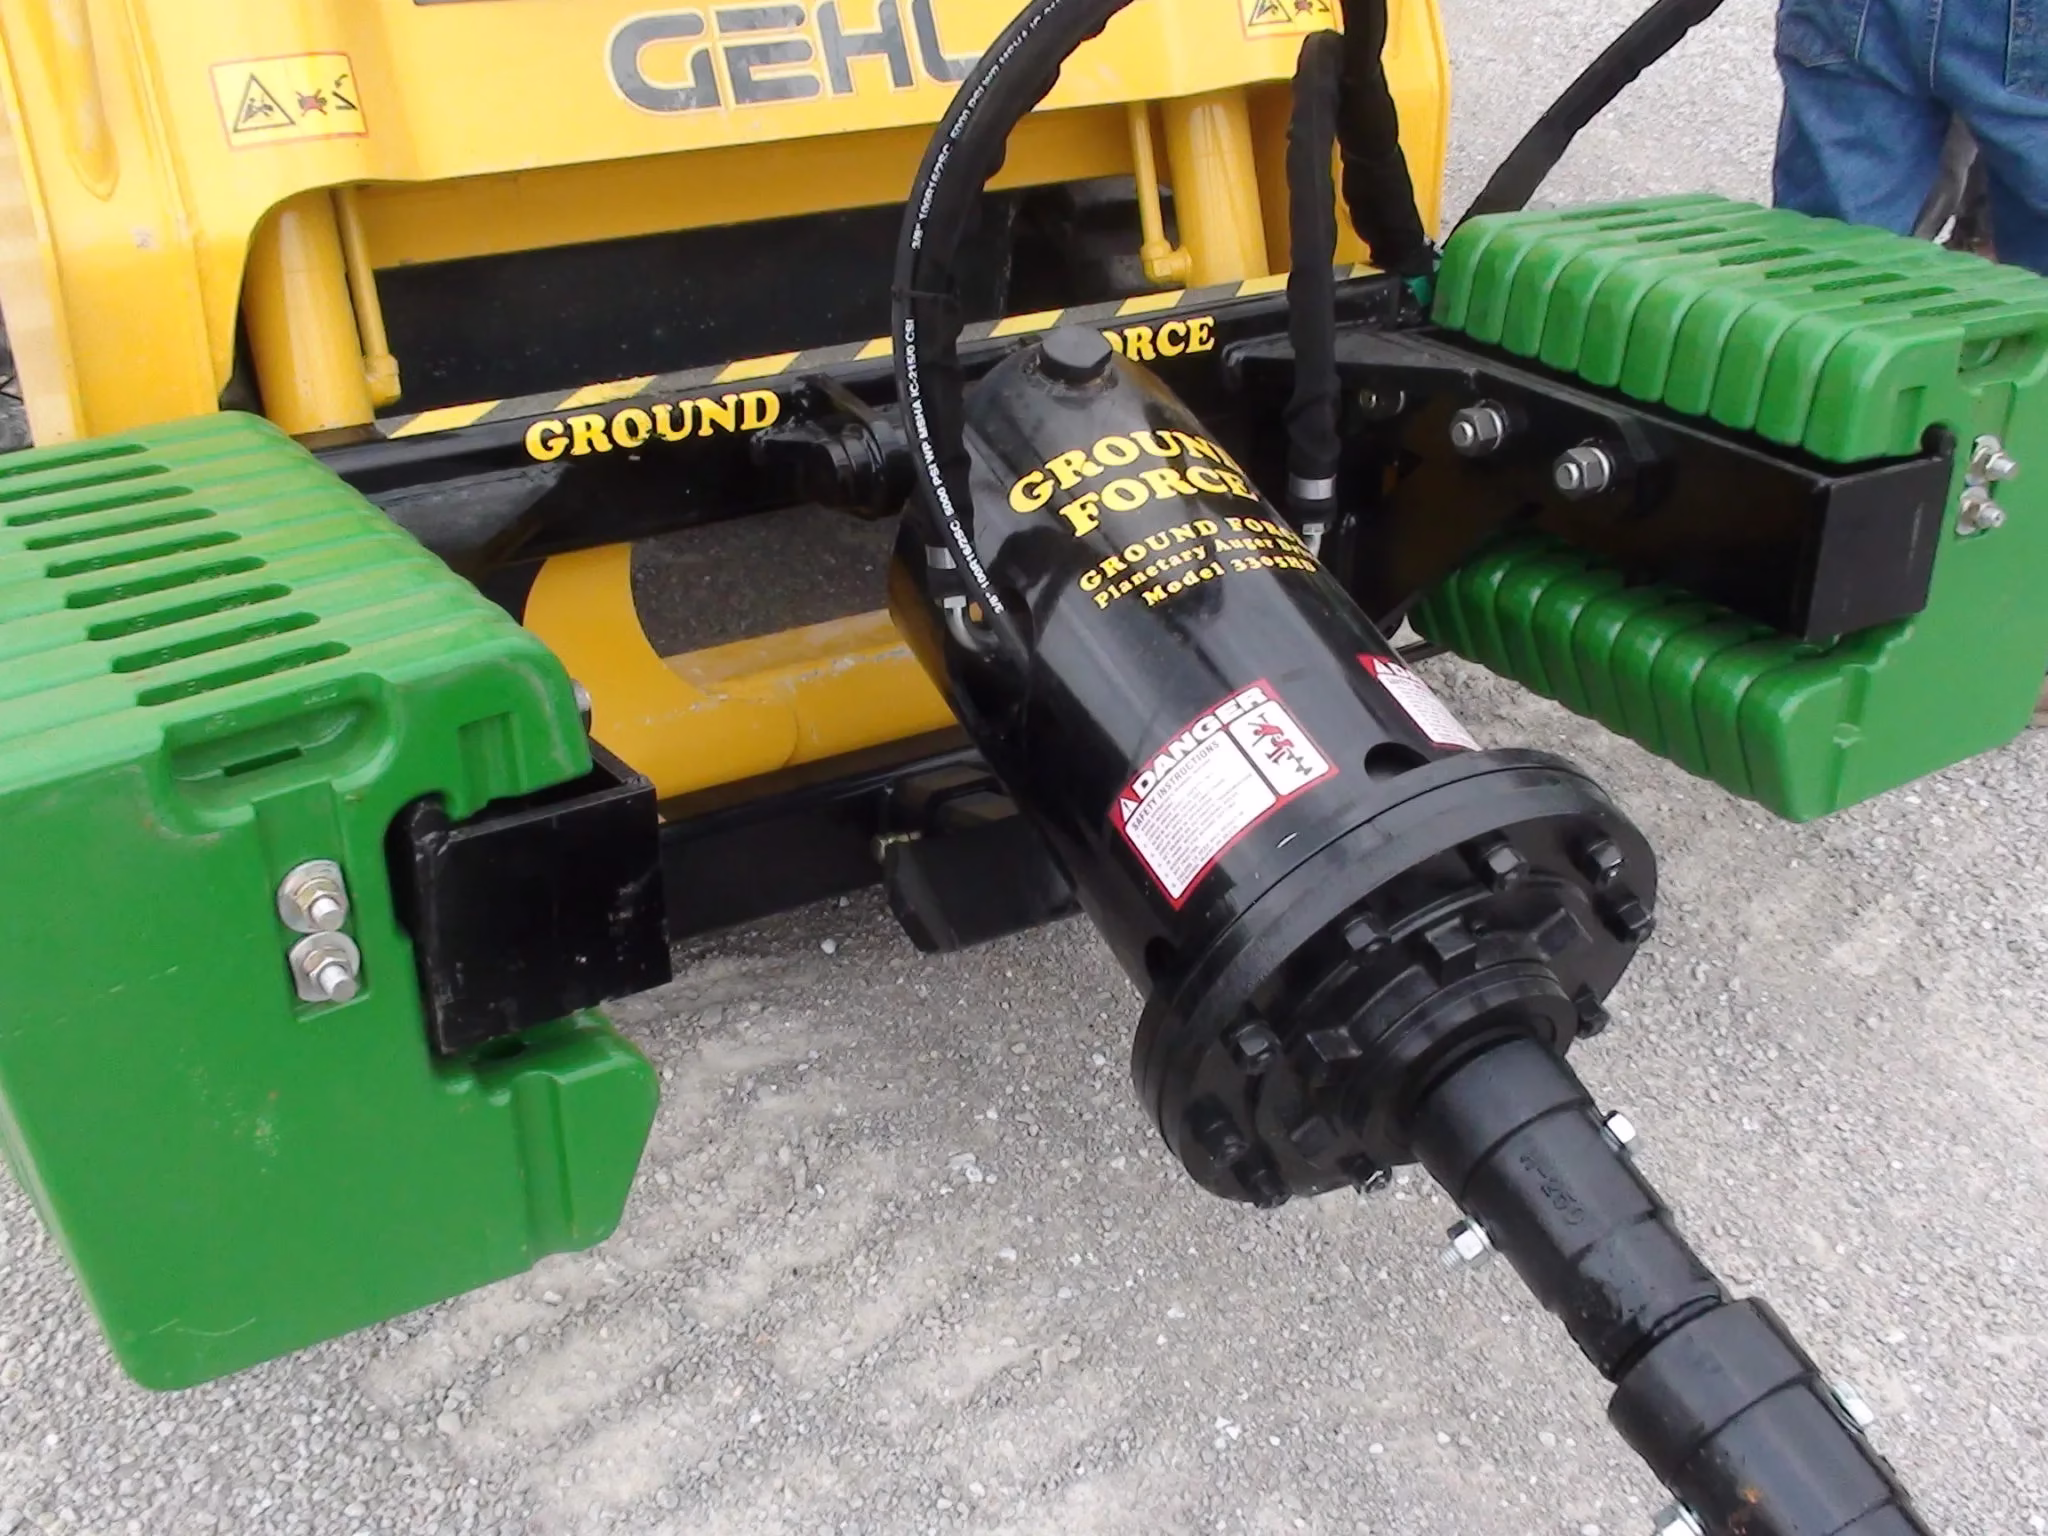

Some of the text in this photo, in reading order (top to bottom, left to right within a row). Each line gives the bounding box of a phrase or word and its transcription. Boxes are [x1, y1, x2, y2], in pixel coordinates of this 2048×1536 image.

[606, 0, 986, 112] GEHL
[905, 319, 915, 341] CSI
[1101, 316, 1216, 362] RCE
[525, 390, 781, 462] GROUND
[911, 398, 930, 442] MSHA
[921, 440, 937, 464] WP
[928, 464, 941, 486] PSI
[936, 486, 955, 517] 5000
[1058, 465, 1259, 537] FORCE
[1079, 519, 1219, 592] GROUND
[1093, 544, 1208, 610] Planetary
[1214, 537, 1275, 553] Auger
[1142, 555, 1318, 608] Model 3305HD
[1131, 686, 1269, 801] DANGER
[1132, 740, 1220, 832] SAFETY INSTRUCTIONS
